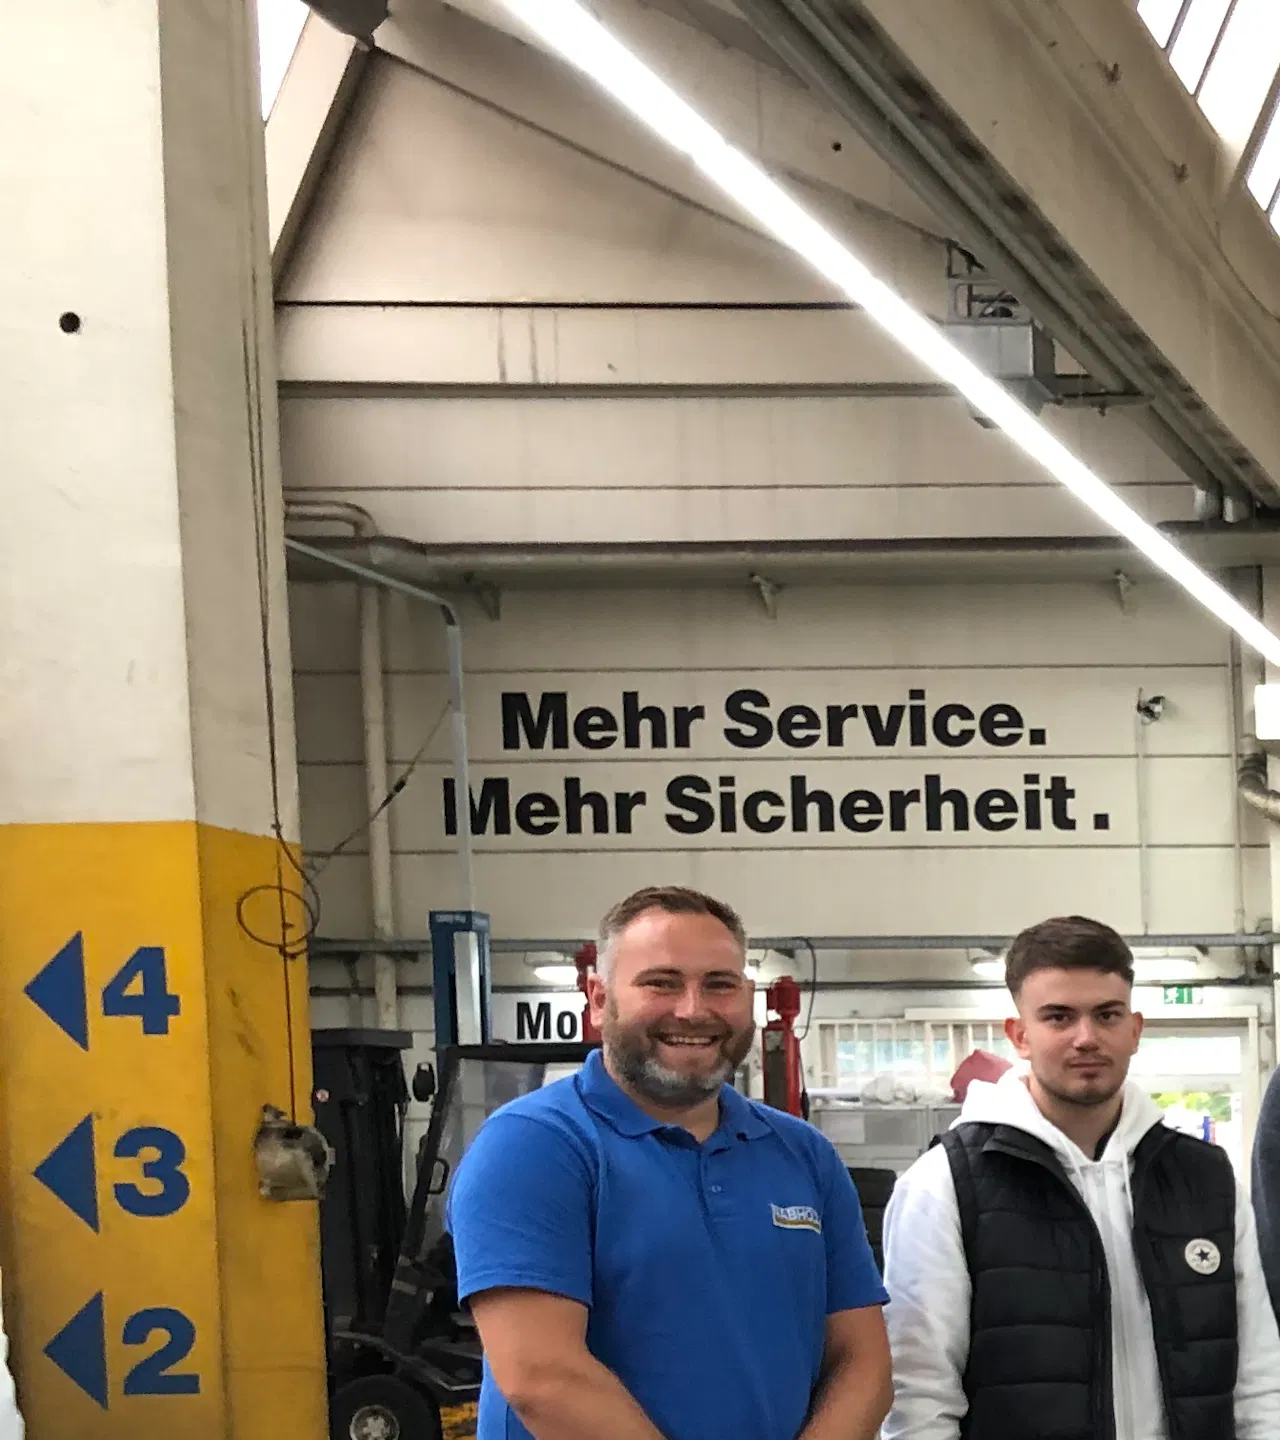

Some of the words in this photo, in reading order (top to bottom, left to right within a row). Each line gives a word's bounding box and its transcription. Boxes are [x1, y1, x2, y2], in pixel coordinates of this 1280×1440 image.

[501, 690, 705, 751] Mehr
[723, 688, 1047, 749] Service.
[443, 776, 645, 836] Mehr
[664, 774, 1110, 834] Sicherheit.
[102, 946, 181, 1036] 4
[113, 1126, 190, 1217] 3
[121, 1307, 201, 1396] 2
